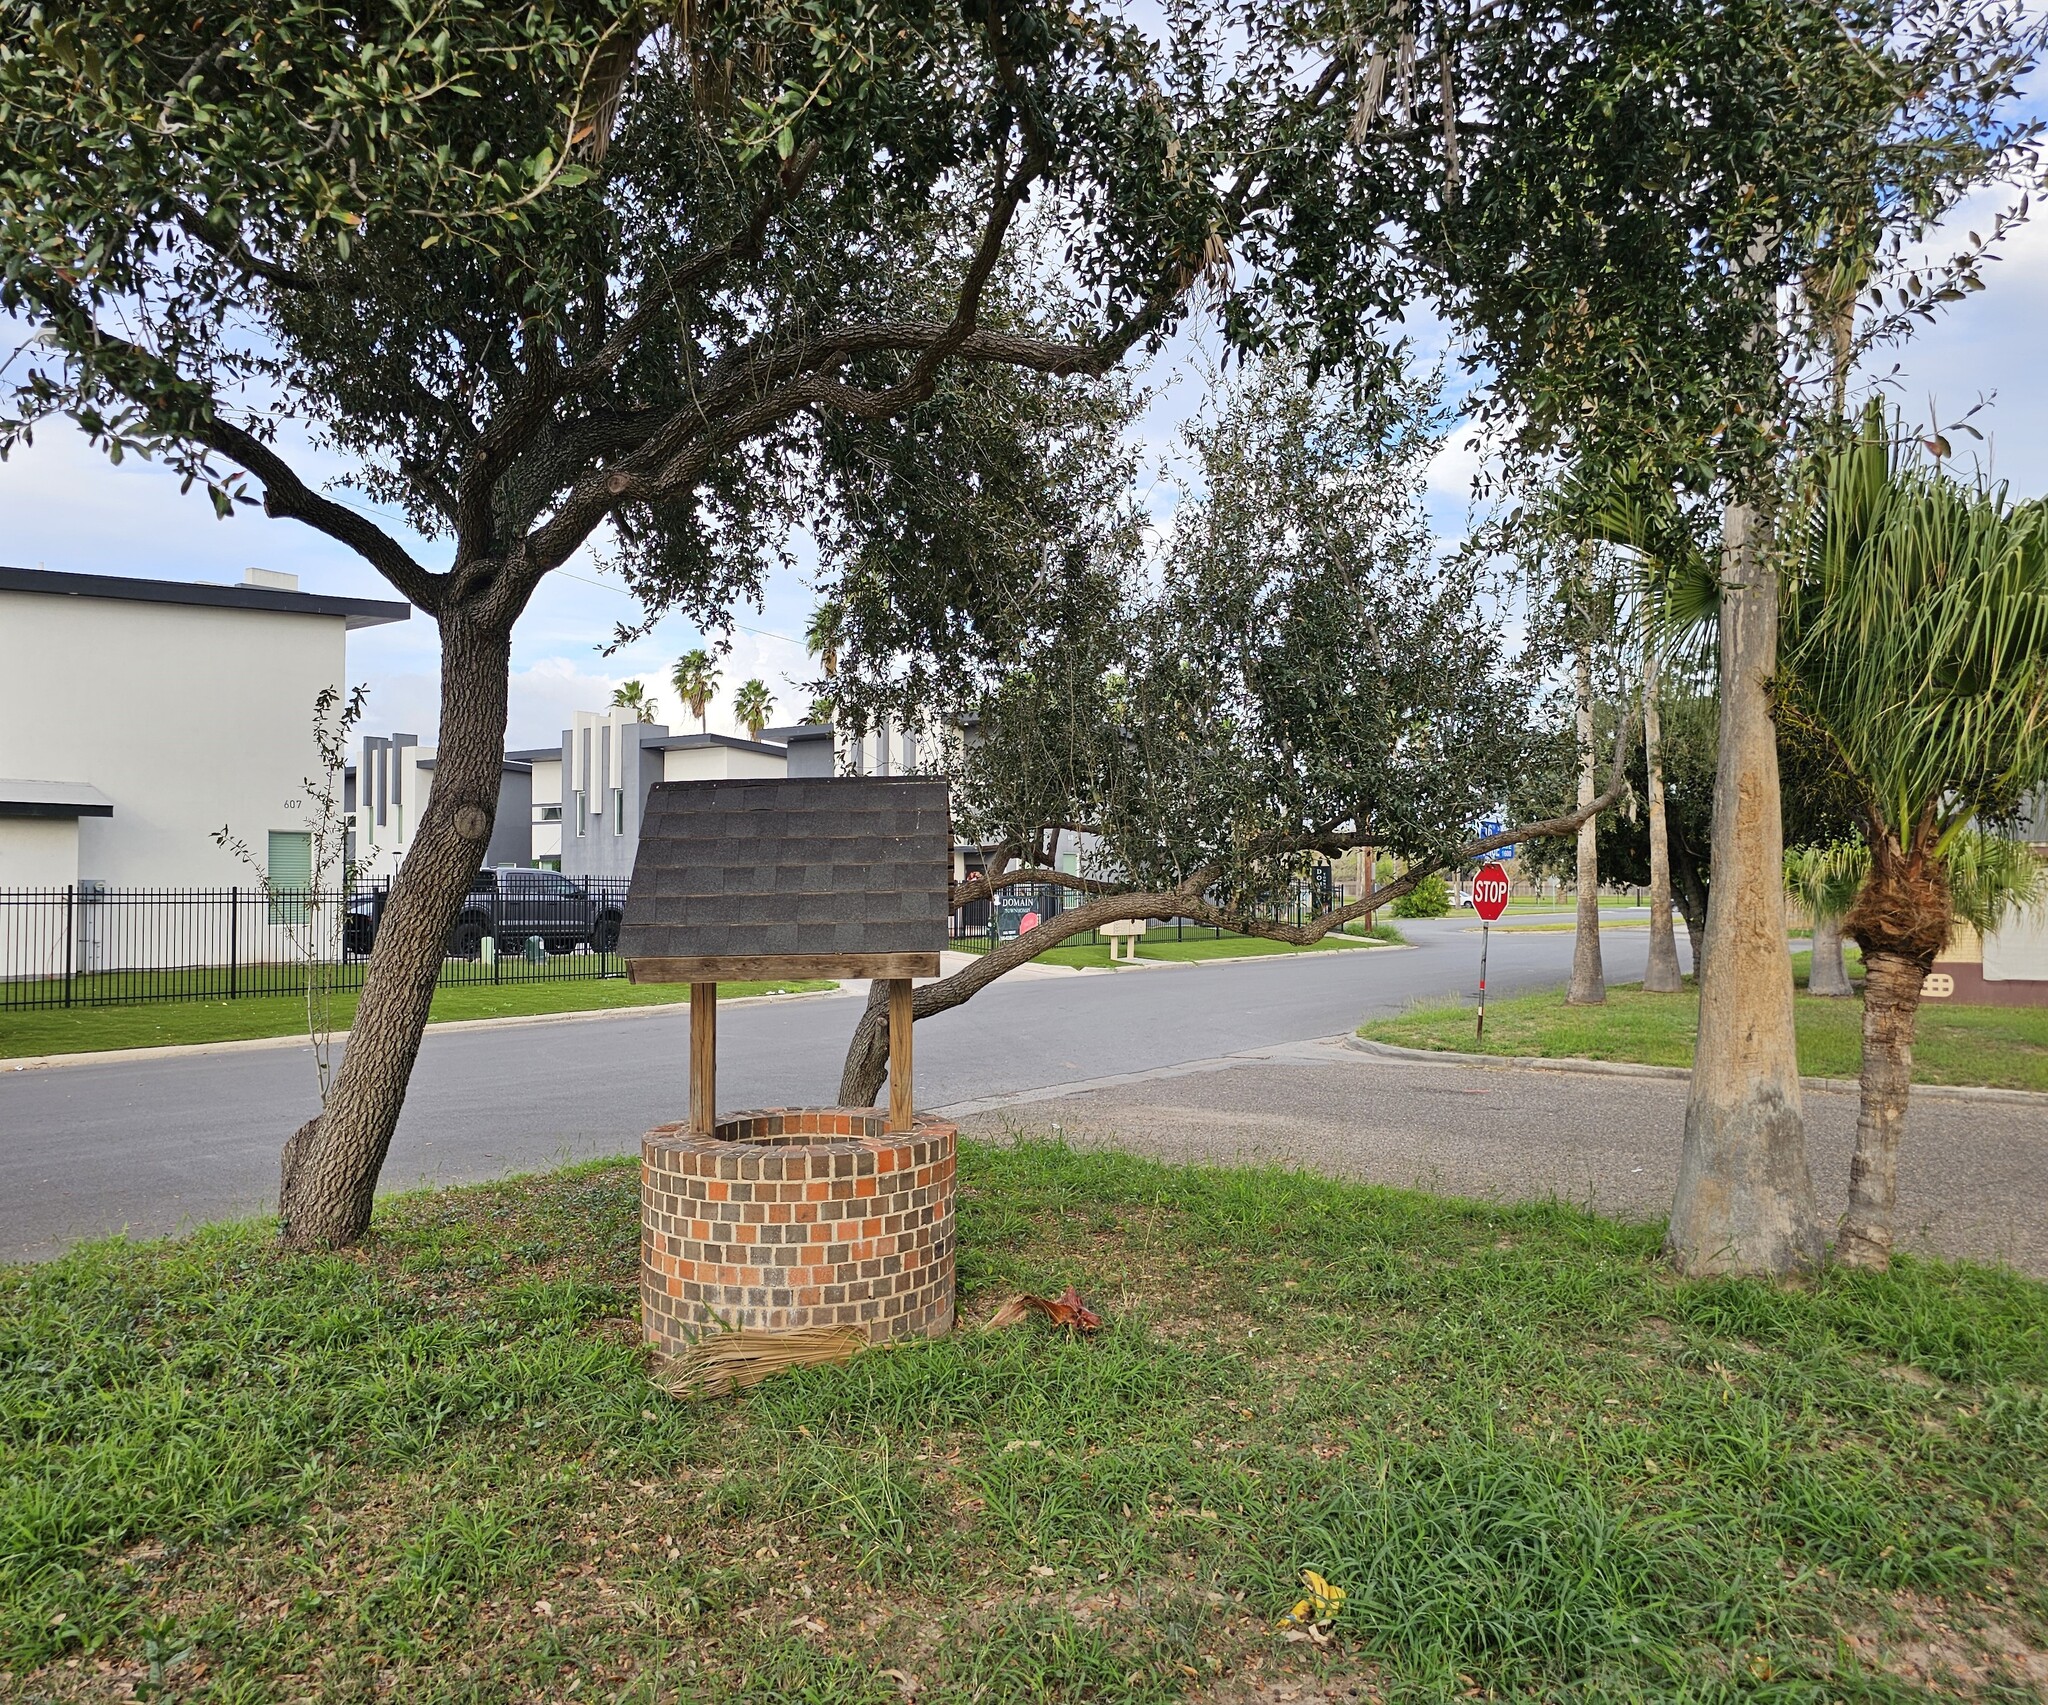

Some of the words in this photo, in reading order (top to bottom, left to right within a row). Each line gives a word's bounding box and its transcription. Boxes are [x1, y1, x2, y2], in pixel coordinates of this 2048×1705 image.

[284, 799, 302, 809] 607
[1475, 880, 1507, 903] STOP
[1002, 898, 1034, 907] DOMAIN
